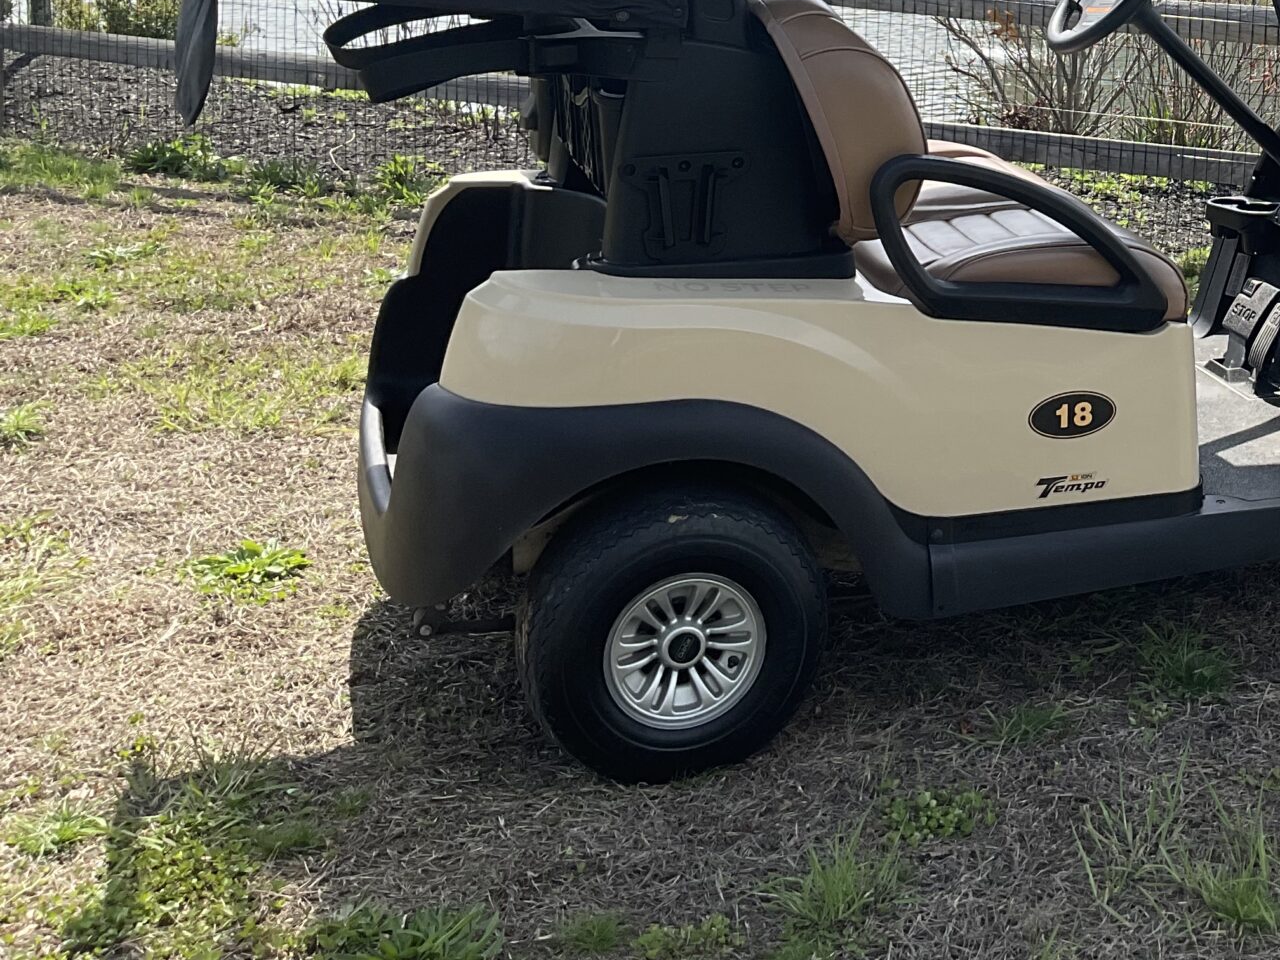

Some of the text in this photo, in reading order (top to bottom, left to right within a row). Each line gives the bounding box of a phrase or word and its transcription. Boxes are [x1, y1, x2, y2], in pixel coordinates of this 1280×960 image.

[653, 281, 811, 293] NO STEP
[1232, 303, 1257, 322] STOP
[1055, 401, 1093, 428] 18
[1036, 476, 1106, 498] Tempo
